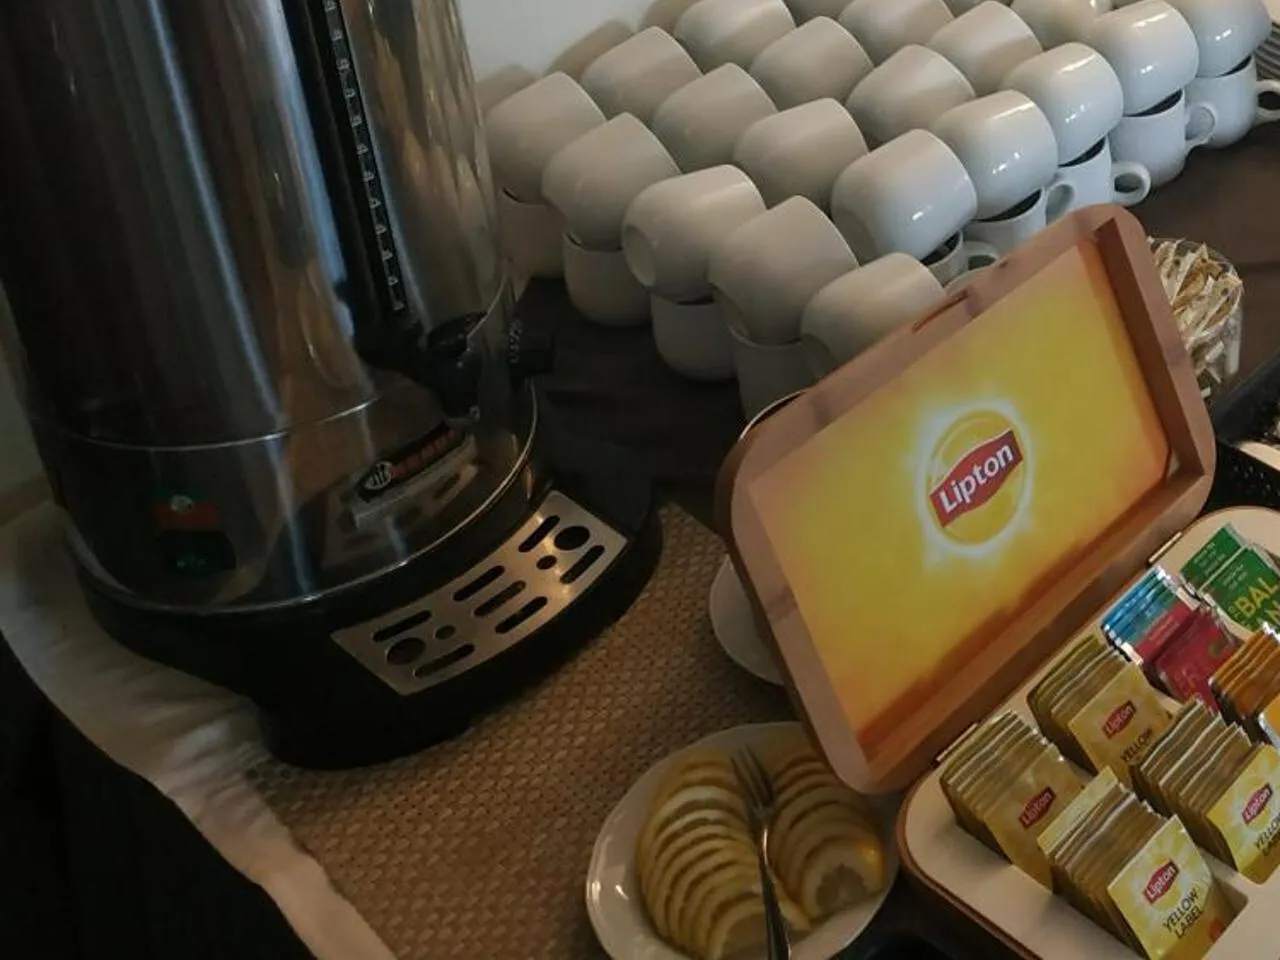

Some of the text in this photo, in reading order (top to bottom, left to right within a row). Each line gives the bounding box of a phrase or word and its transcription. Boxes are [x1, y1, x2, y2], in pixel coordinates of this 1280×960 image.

[938, 444, 1015, 515] Lipton
[1233, 576, 1279, 618] BAL
[1105, 705, 1134, 735] Lipton
[1245, 788, 1271, 822] Lipton
[1146, 866, 1177, 899] Lipton
[1162, 887, 1199, 932] YELLOW
[1175, 906, 1204, 939] LABEL
